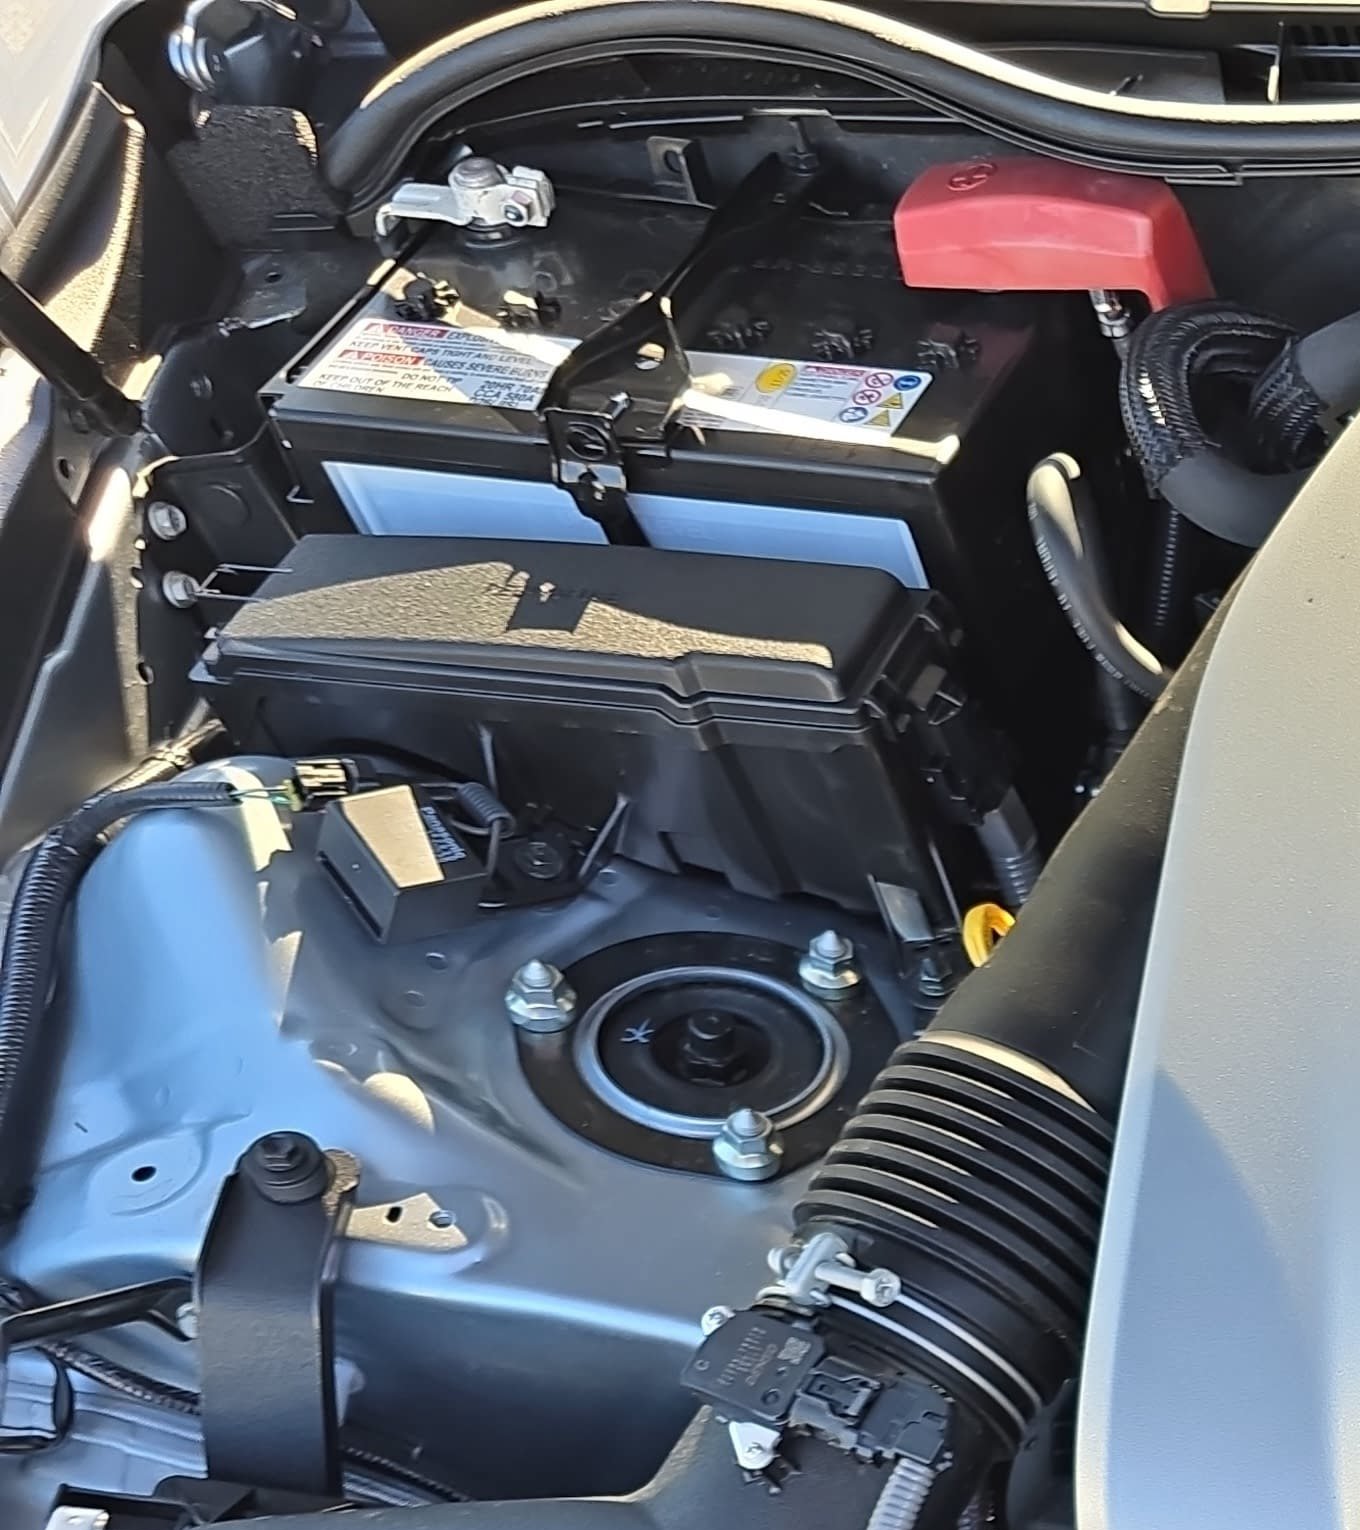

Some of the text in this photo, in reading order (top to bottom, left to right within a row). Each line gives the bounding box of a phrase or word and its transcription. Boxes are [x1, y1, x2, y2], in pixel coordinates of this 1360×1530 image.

[389, 326, 441, 337] DANGER
[350, 340, 379, 348] KEEP
[381, 343, 408, 352] VENT
[411, 346, 440, 355] CAPS
[360, 353, 414, 365] POISON
[423, 358, 467, 370] CAUSES
[466, 361, 509, 374] SEVERE
[319, 373, 349, 381] KEEP
[373, 378, 390, 387] OF
[391, 380, 415, 390] THE
[414, 383, 454, 393] REACH
[401, 372, 420, 381] DO
[419, 375, 443, 384] NOT
[473, 388, 502, 400] CCA
